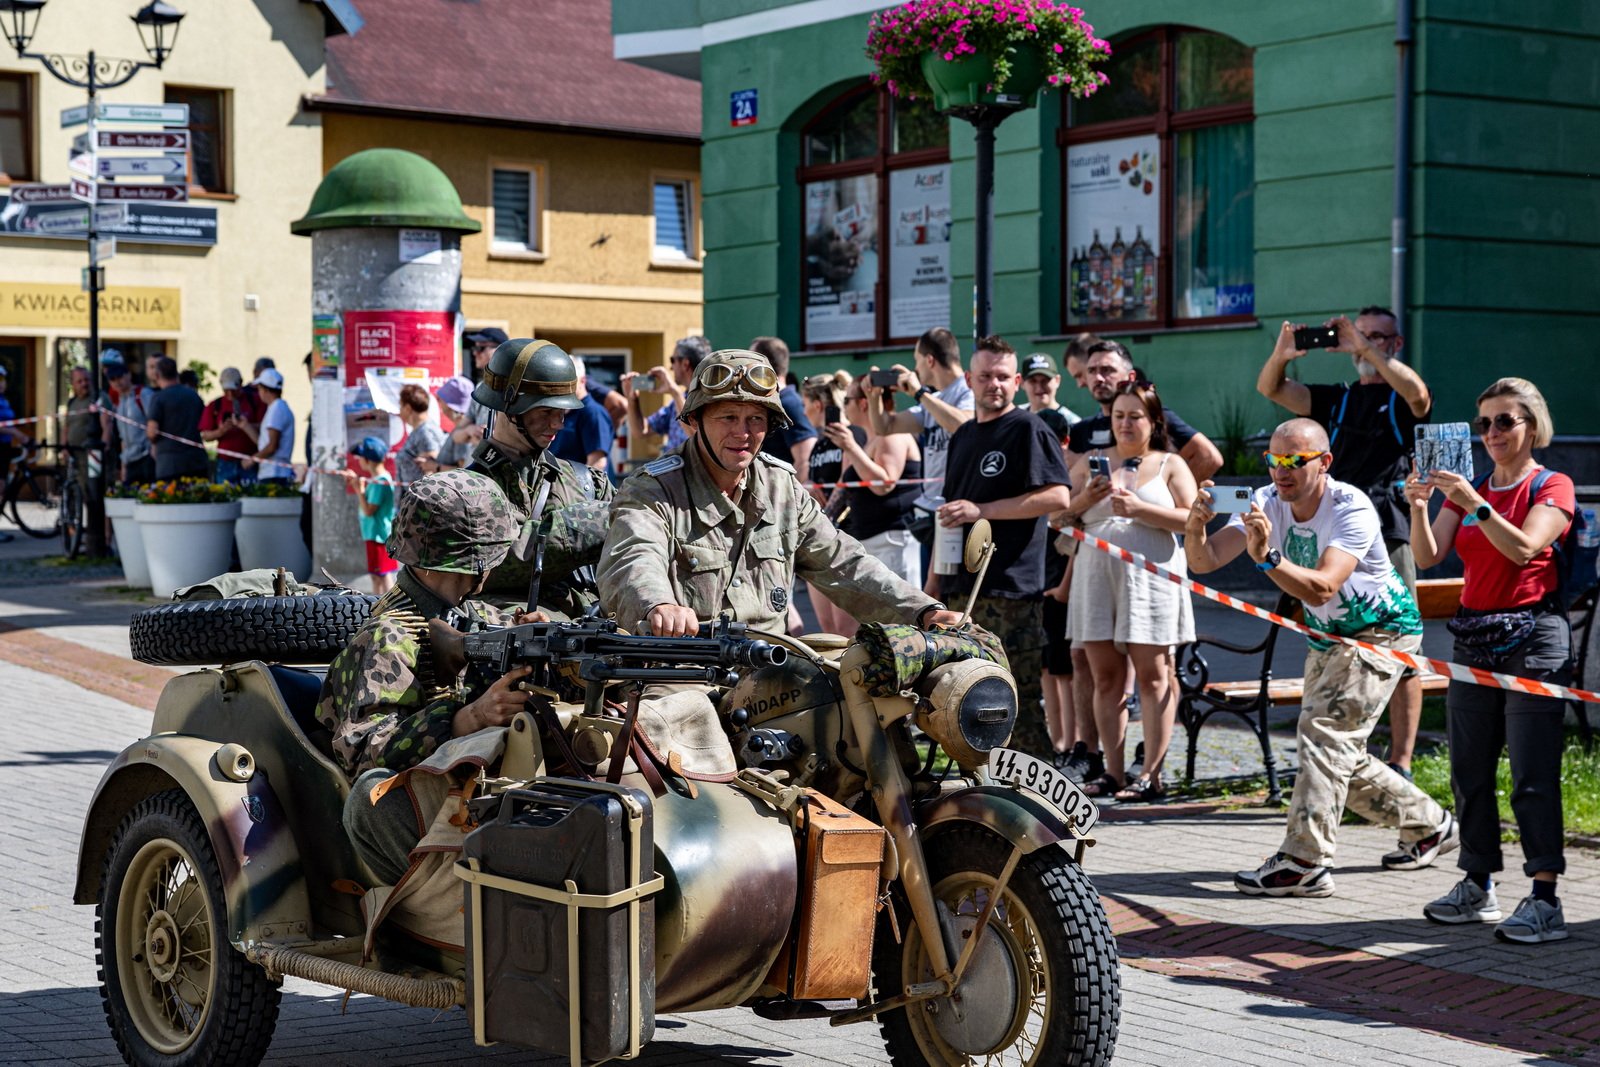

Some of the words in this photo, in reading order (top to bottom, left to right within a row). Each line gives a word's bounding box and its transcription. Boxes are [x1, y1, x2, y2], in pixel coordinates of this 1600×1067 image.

[131, 161, 149, 171] WC
[13, 294, 164, 314] KWIACARNIA
[360, 328, 390, 338] BLACK
[360, 338, 379, 347] RED
[360, 347, 390, 357] WHITE
[743, 689, 801, 718] NDAPP
